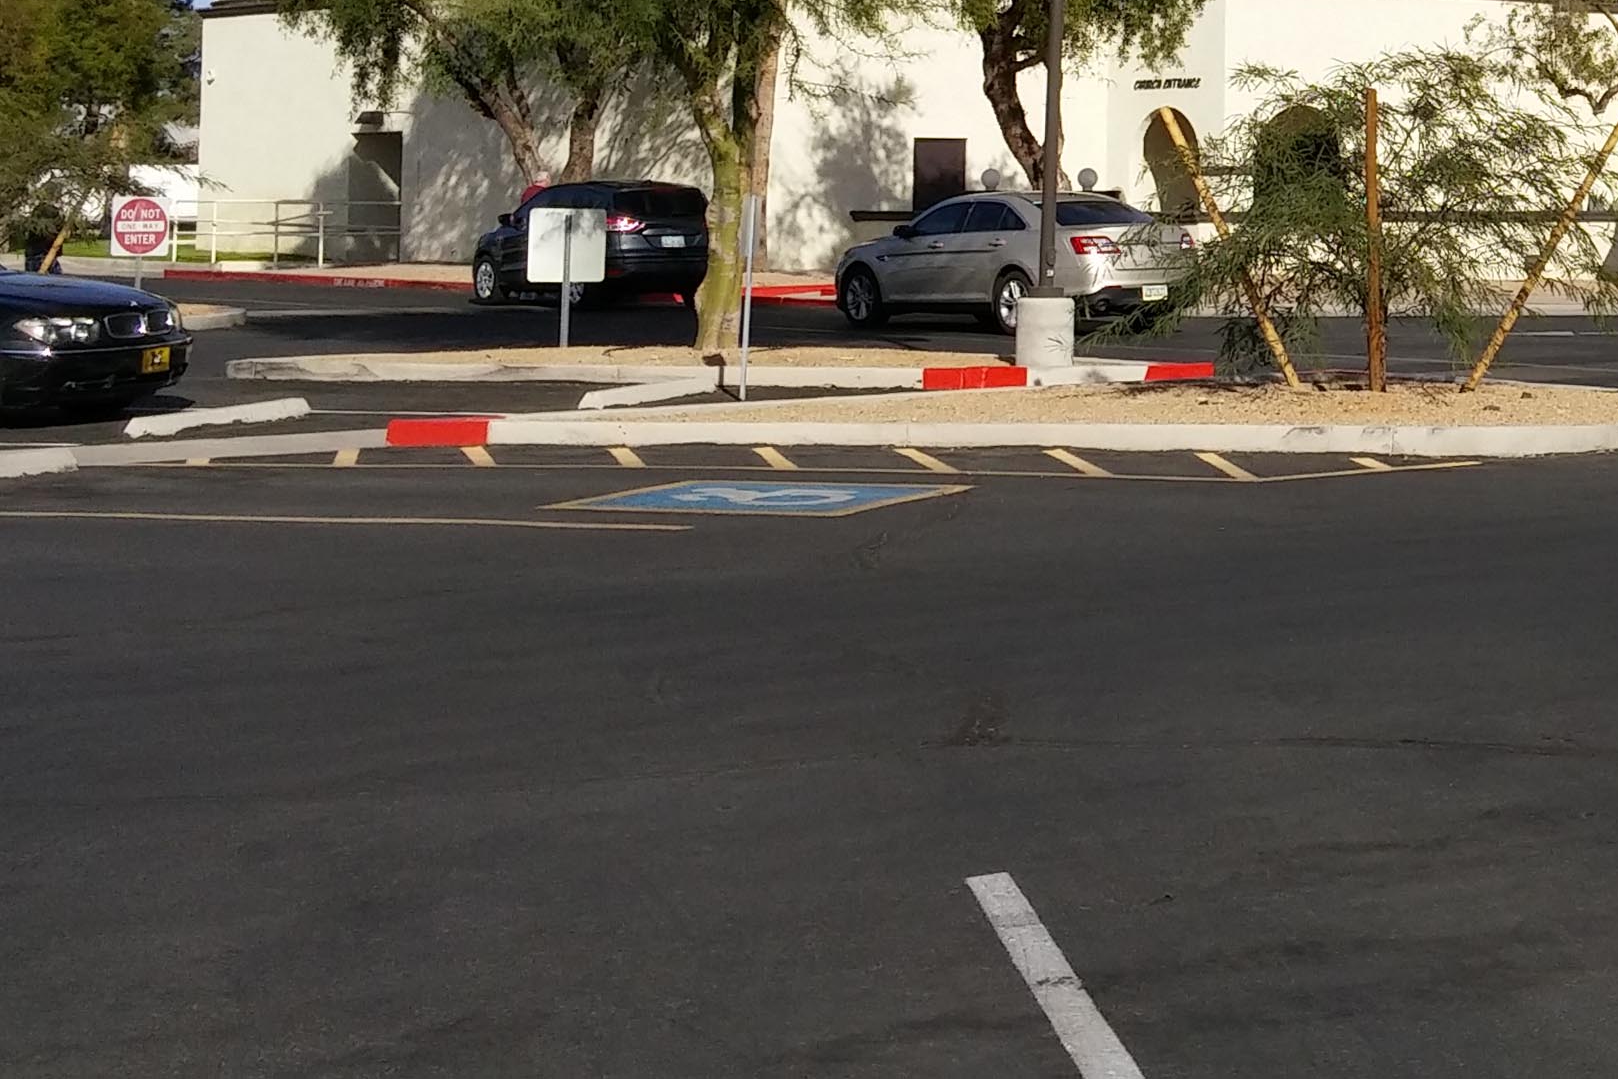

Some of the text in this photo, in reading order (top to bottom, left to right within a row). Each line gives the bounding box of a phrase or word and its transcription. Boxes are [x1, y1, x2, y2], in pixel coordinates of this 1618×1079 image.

[120, 208, 161, 219] DO NOT
[124, 233, 156, 245] ENTER
